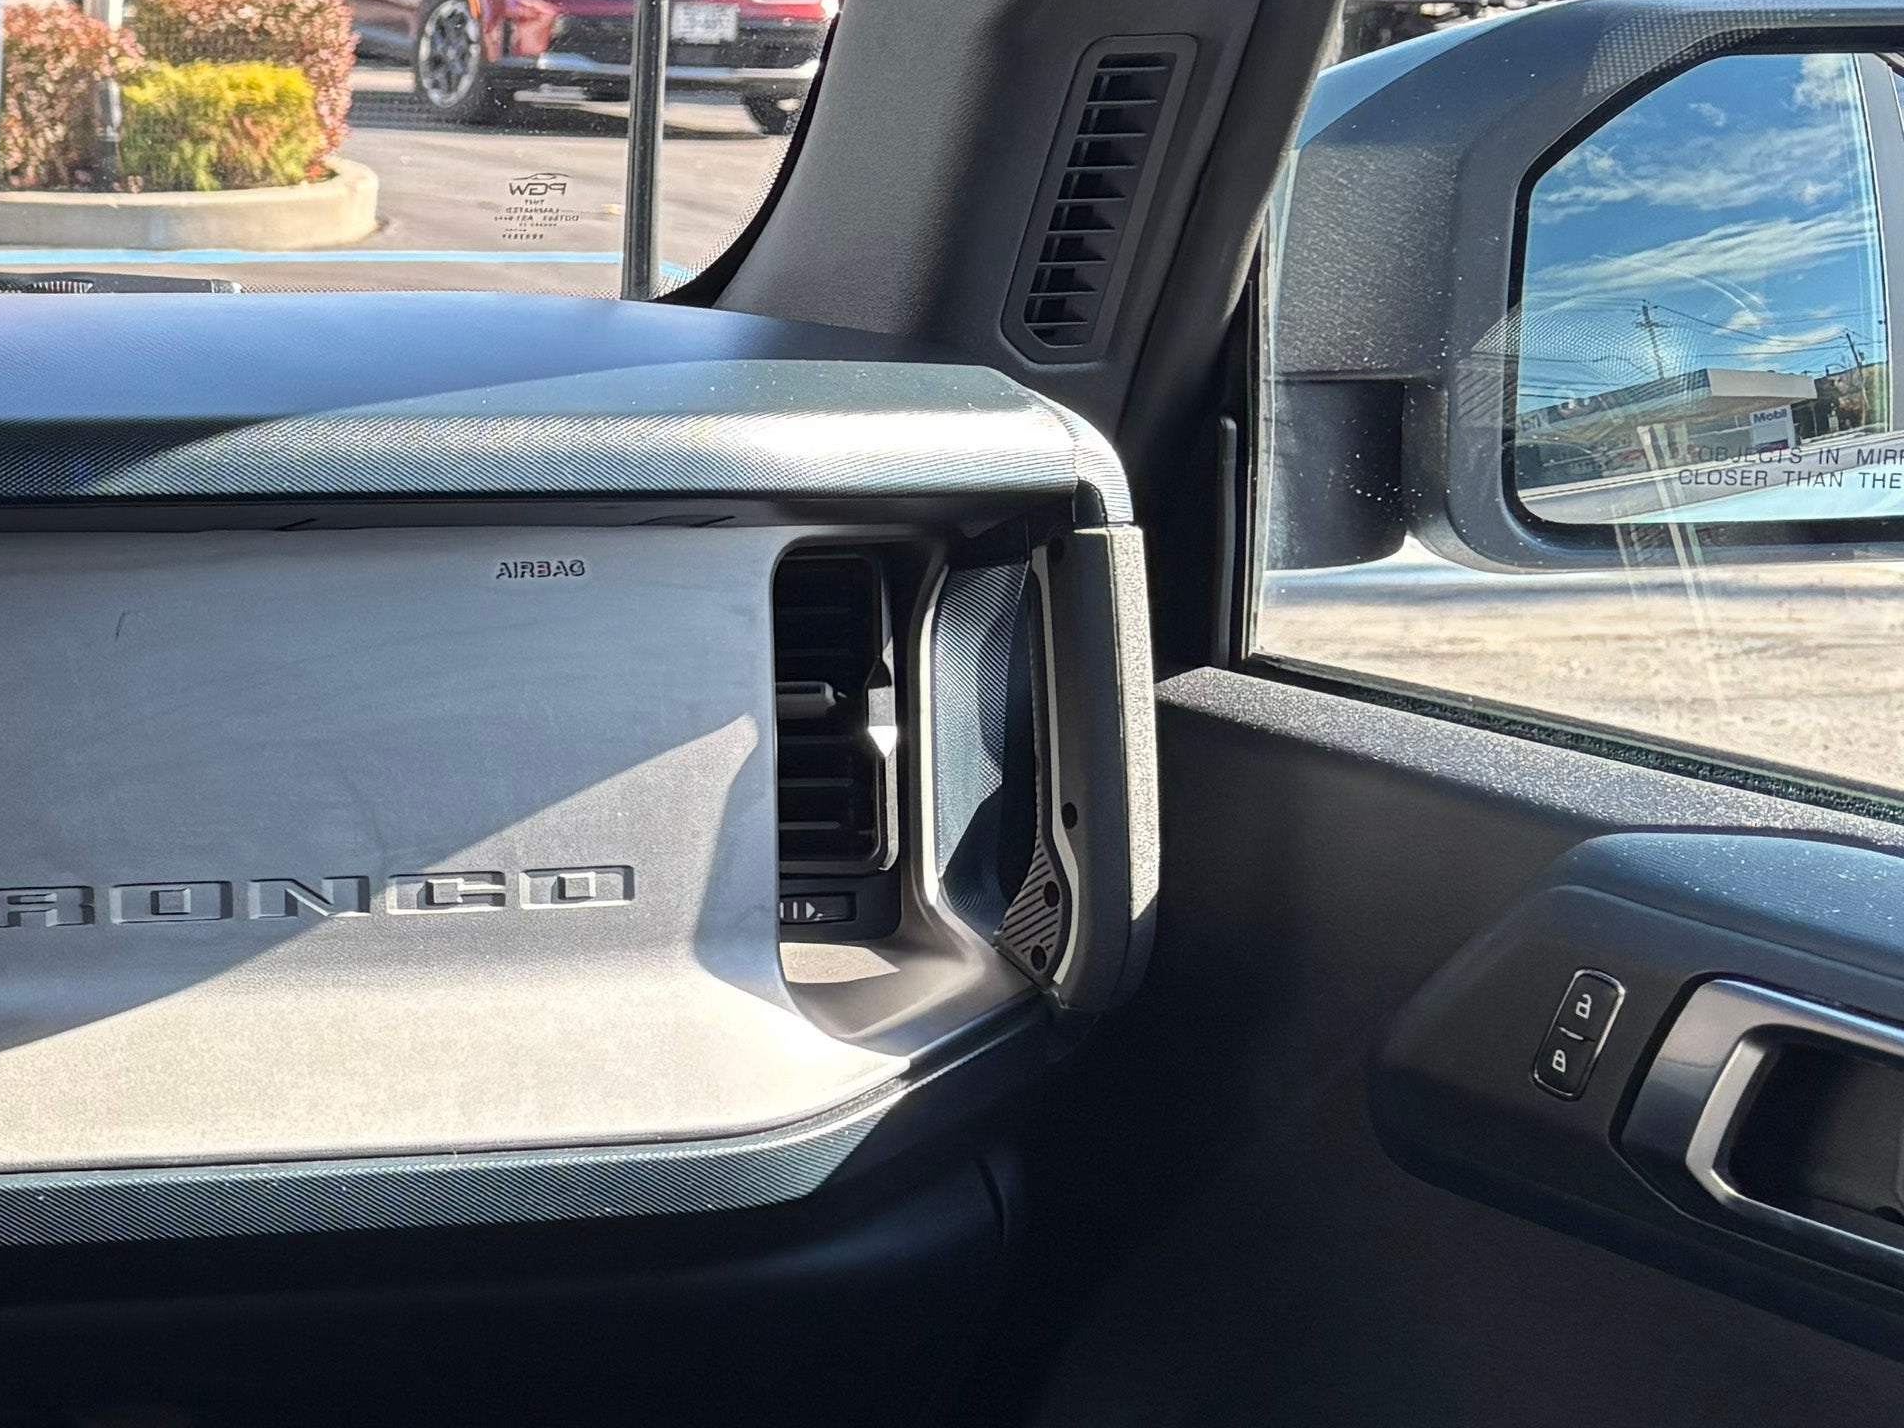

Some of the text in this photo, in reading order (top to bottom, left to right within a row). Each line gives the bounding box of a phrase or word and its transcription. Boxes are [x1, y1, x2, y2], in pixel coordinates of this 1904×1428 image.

[1753, 408, 1788, 424] Mobil
[1699, 446, 1803, 465] OBJECTS
[1819, 448, 1840, 465] IN
[1678, 469, 1768, 487] CLOSER
[1785, 471, 1843, 488] THAN
[495, 559, 586, 579] AIRBAG
